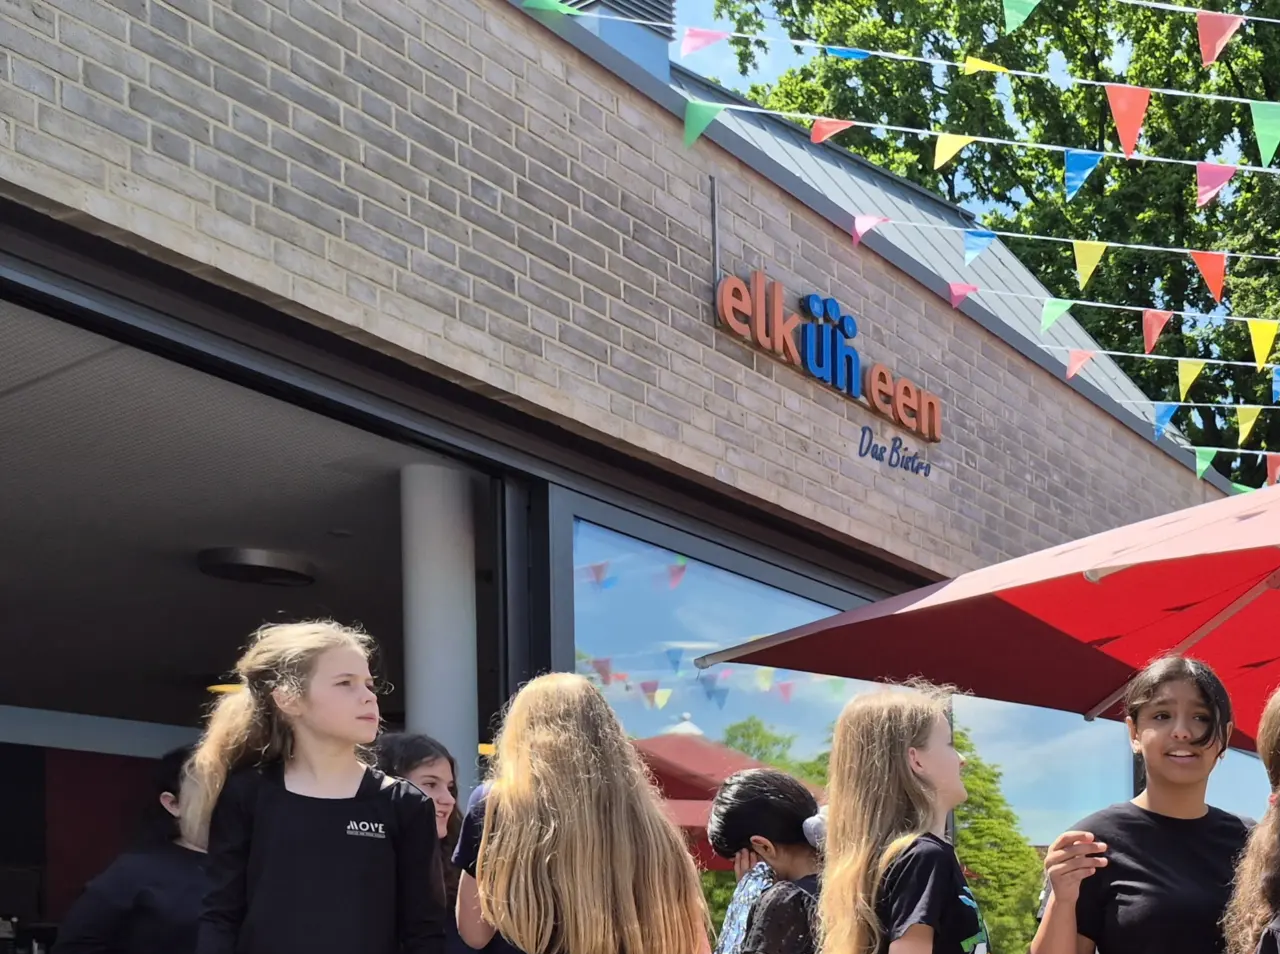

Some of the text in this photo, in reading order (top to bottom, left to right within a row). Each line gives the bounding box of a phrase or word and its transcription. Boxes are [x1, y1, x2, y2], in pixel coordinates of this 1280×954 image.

[858, 425, 931, 477] Das Bistro
[346, 820, 386, 834] MOVE
